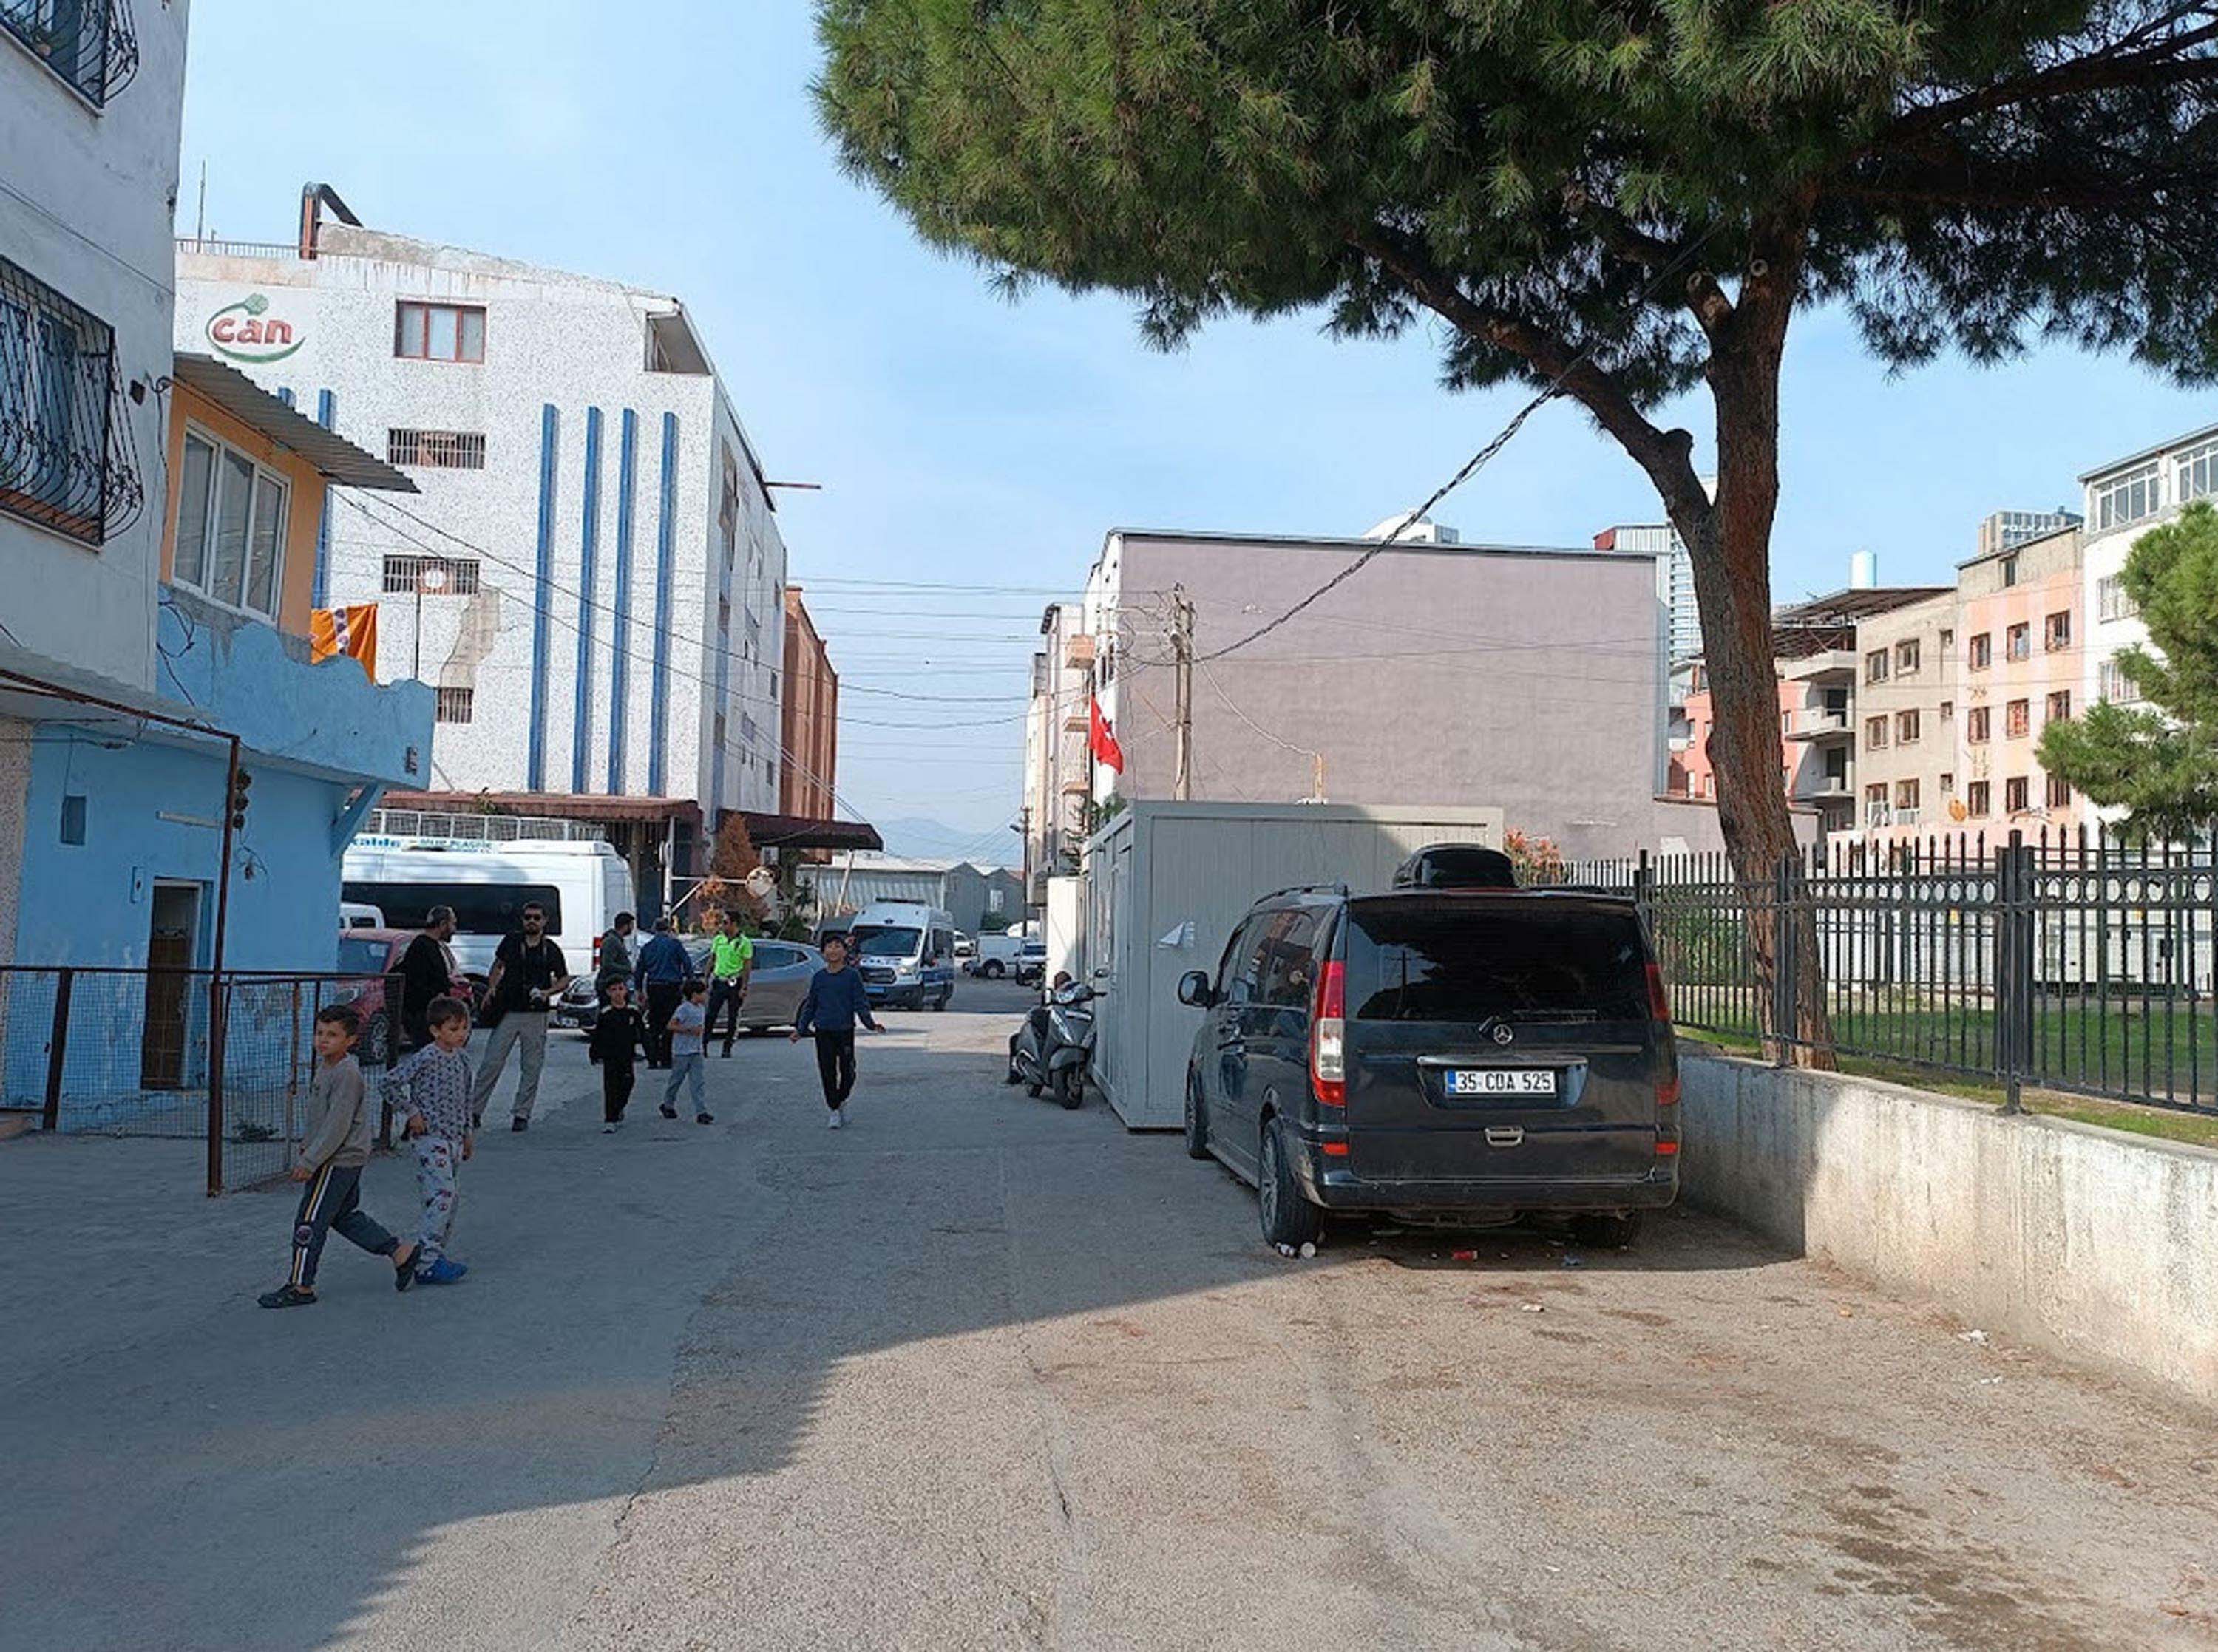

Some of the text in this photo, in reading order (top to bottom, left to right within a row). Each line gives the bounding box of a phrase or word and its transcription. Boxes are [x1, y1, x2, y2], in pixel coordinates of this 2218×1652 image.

[212, 318, 293, 344] can
[1457, 1073, 1552, 1091] 35 CDA 525
